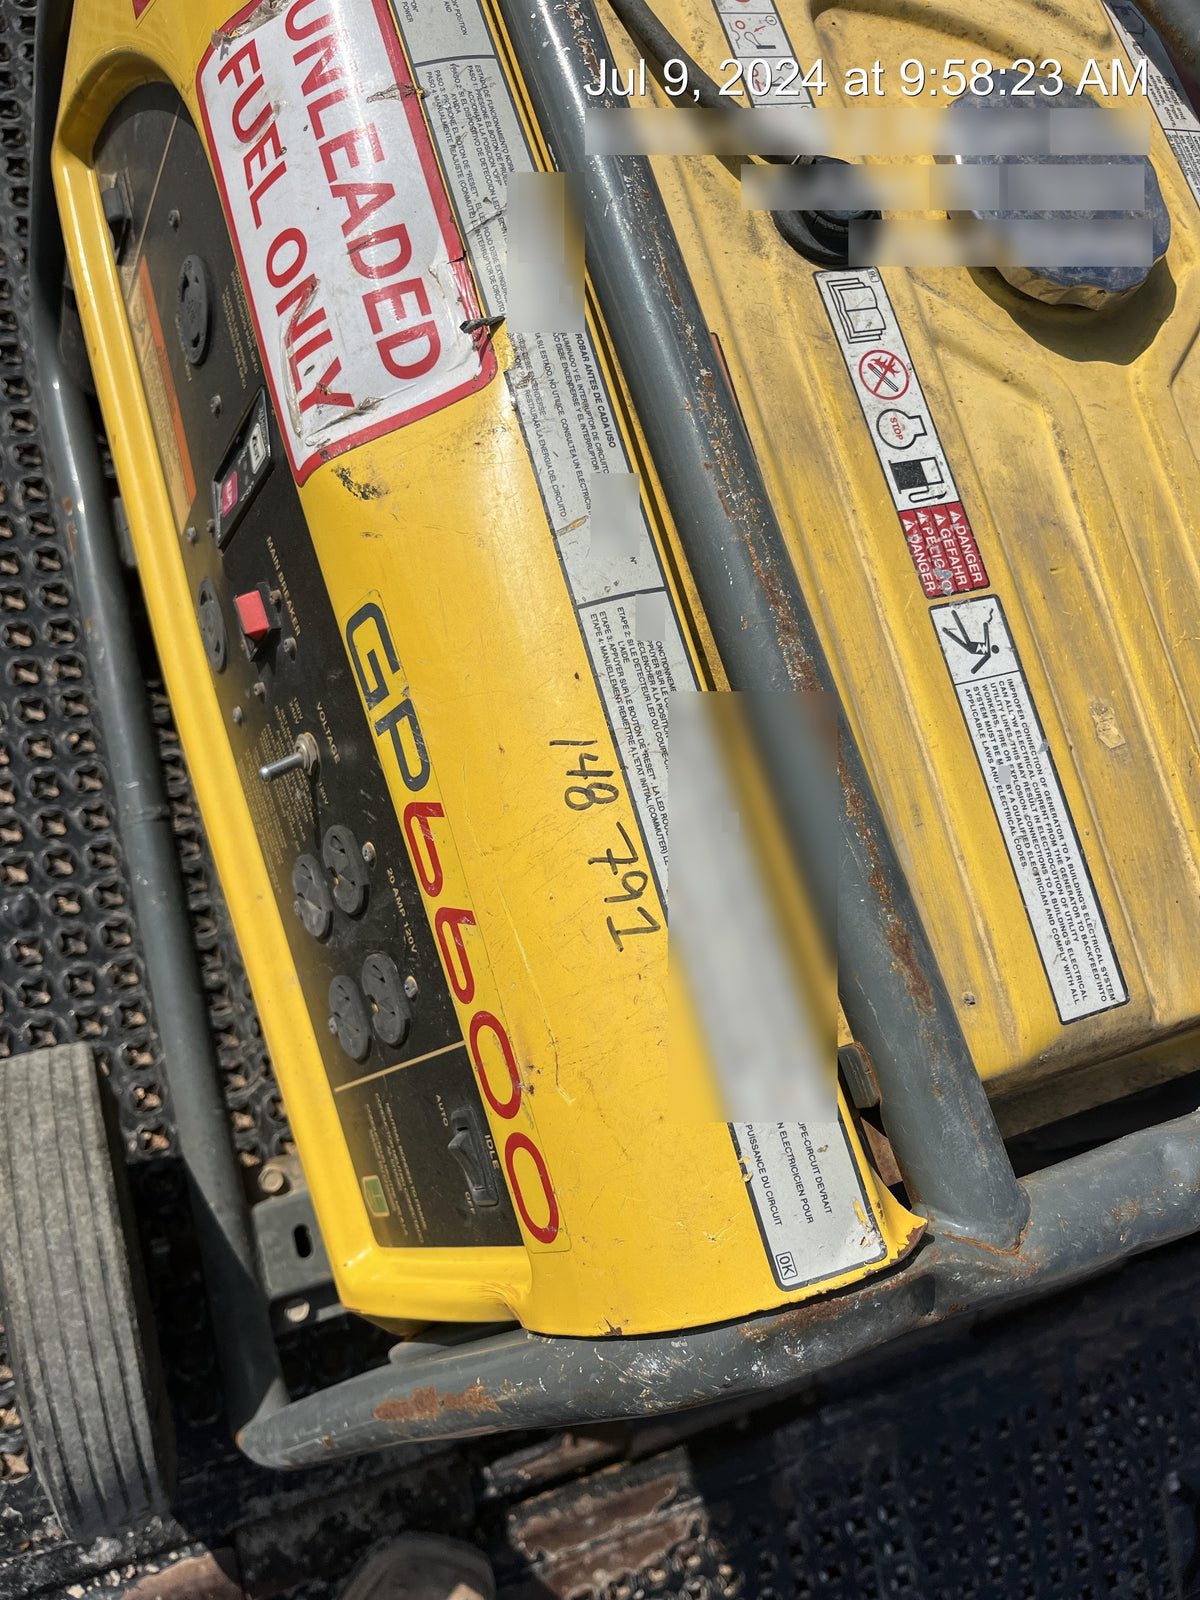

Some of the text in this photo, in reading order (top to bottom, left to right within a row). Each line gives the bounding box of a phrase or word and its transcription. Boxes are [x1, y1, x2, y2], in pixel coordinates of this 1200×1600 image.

[218, 39, 288, 229] FUEL
[285, 0, 441, 380] UNLEADED
[266, 228, 356, 415] ONLY
[583, 363, 598, 391] ANTES
[592, 392, 602, 403] DE
[555, 343, 567, 360] DEBE
[561, 362, 580, 406] ENCENDERSE
[579, 423, 599, 469] INTERRUPTOR
[576, 384, 596, 430] INTERRUPTOR
[596, 405, 610, 428] CADA
[888, 416, 904, 441] STOP
[603, 430, 616, 447] USO
[922, 525, 952, 591] PELIGO
[939, 526, 967, 586] GEFAHR
[955, 524, 982, 583] DANGER
[265, 535, 302, 636] MAIN BREAKER
[616, 607, 629, 630] ETAPE
[631, 657, 651, 702] DETECTEUR
[645, 703, 656, 718] LED
[617, 640, 630, 663] L'AIDE
[598, 611, 612, 634] ETAPE
[608, 643, 624, 677] APPUYER
[618, 677, 630, 694] SUR
[627, 705, 642, 737] BOUTON
[654, 796, 665, 812] LED
[990, 682, 1004, 712] UTILITY
[1006, 678, 1025, 720] IMPROPER
[314, 700, 341, 764] VOLTAGE
[590, 613, 603, 637] ETAPE
[599, 645, 623, 705] MANUELLEMENT
[617, 705, 635, 746] REMETTRE
[631, 752, 644, 777] L'ETAT
[638, 777, 652, 803] INITIAL
[646, 804, 667, 854] (COMMUTER)
[1009, 742, 1020, 761] THIS
[1020, 721, 1043, 777] CONNECTION
[964, 687, 985, 738] APPLICABLE
[981, 740, 994, 764] LAWS
[989, 764, 1000, 783] AND
[995, 784, 1017, 836] ELECTRICAL
[1012, 838, 1027, 869] CODES.
[1015, 762, 1026, 780] MAY
[1038, 777, 1047, 788] OF
[1022, 781, 1037, 813] RESULT
[1032, 813, 1040, 824] IN
[1042, 790, 1064, 841] GENERATOR
[972, 685, 988, 719] SYSTEM
[984, 720, 996, 744] MUST
[992, 745, 1000, 757] BE
[1004, 784, 1013, 796] BY
[1011, 804, 1030, 849] QUALIFIED
[1025, 850, 1048, 906] ELECTRICIAN
[1044, 907, 1055, 926] AND
[1050, 927, 1067, 963] COMPLY
[1062, 964, 1074, 986] WITH
[1070, 987, 1080, 1005] ALL
[981, 683, 1000, 728] WORKERS,
[996, 729, 1007, 748] FIRE
[1002, 749, 1011, 762] OR
[1023, 815, 1048, 875] CONNECTIONS
[1043, 876, 1052, 889] TO
[1050, 898, 1070, 946] BUILDING'S
[1066, 947, 1088, 1000] ELECTRICAL
[998, 679, 1009, 698] CAN
[1014, 729, 1035, 780] ELECTRICAL
[1031, 781, 1048, 821] CURRENT
[1044, 822, 1057, 847] FROM
[1052, 848, 1063, 866] THE
[1058, 866, 1080, 919] GENERATOR
[1075, 920, 1084, 933] TO
[1080, 934, 1100, 980] BACKFEED
[1095, 981, 1107, 1002] INTO
[1036, 825, 1063, 896] ELECTROCUTION
[1060, 842, 1068, 854] TO
[385, 867, 417, 953] 20 AMP 120V
[1059, 897, 1068, 909] OF
[1066, 863, 1087, 911] BUILDING'S
[345, 602, 560, 1244] GP6600
[1063, 910, 1078, 943] UTILITY
[1082, 912, 1104, 964] ELECTRICAL
[1100, 966, 1116, 1001] SYSTEM
[434, 1093, 449, 1127] AUTO
[483, 1133, 500, 1170] IDLE
[744, 1123, 782, 1226] PUISSANCE DU CIRCUIT
[779, 1130, 814, 1224] ELECTRICICIEN POUR
[464, 1190, 476, 1215] OFF
[814, 1175, 832, 1214] DEVRAIT
